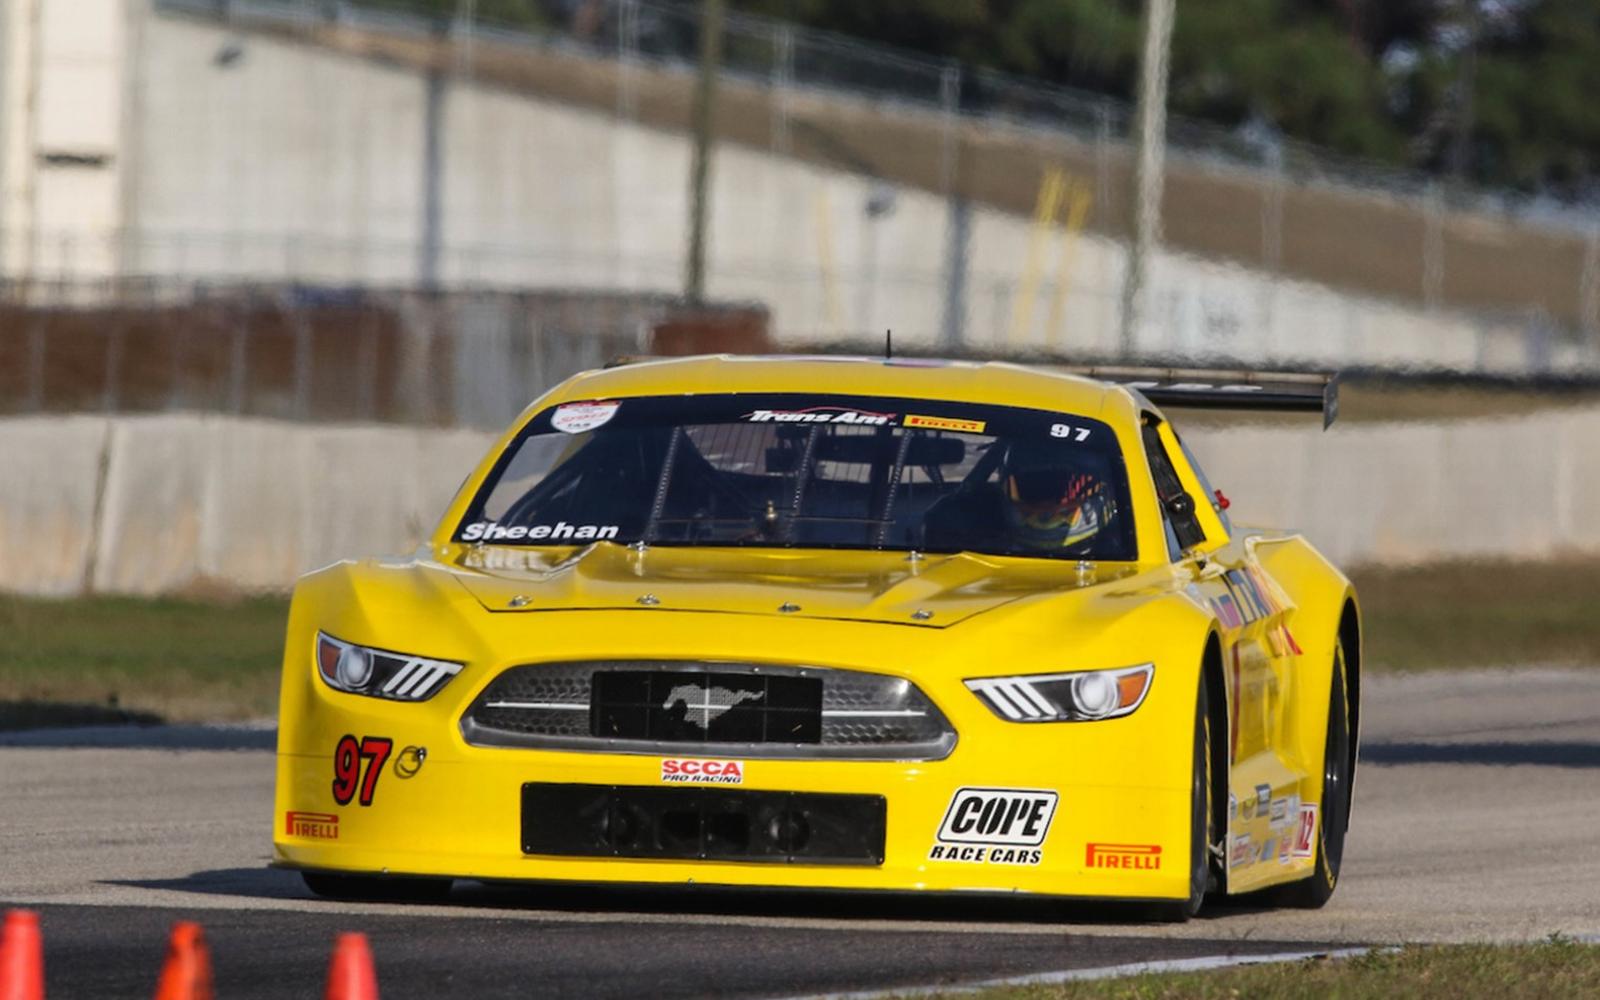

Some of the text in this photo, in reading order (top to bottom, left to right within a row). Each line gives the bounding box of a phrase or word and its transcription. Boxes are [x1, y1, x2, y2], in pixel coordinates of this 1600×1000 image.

[750, 410, 887, 424] Trans Am
[1050, 423, 1091, 442] 97
[461, 522, 619, 541] Sheehan
[332, 734, 393, 806] 97
[662, 759, 741, 776] SCCA
[692, 775, 741, 784] RACING
[286, 811, 339, 838] PIRELLI
[950, 796, 1048, 836] COPE
[929, 846, 1042, 864] RACE CARS
[1086, 842, 1162, 870] PIRELLI
